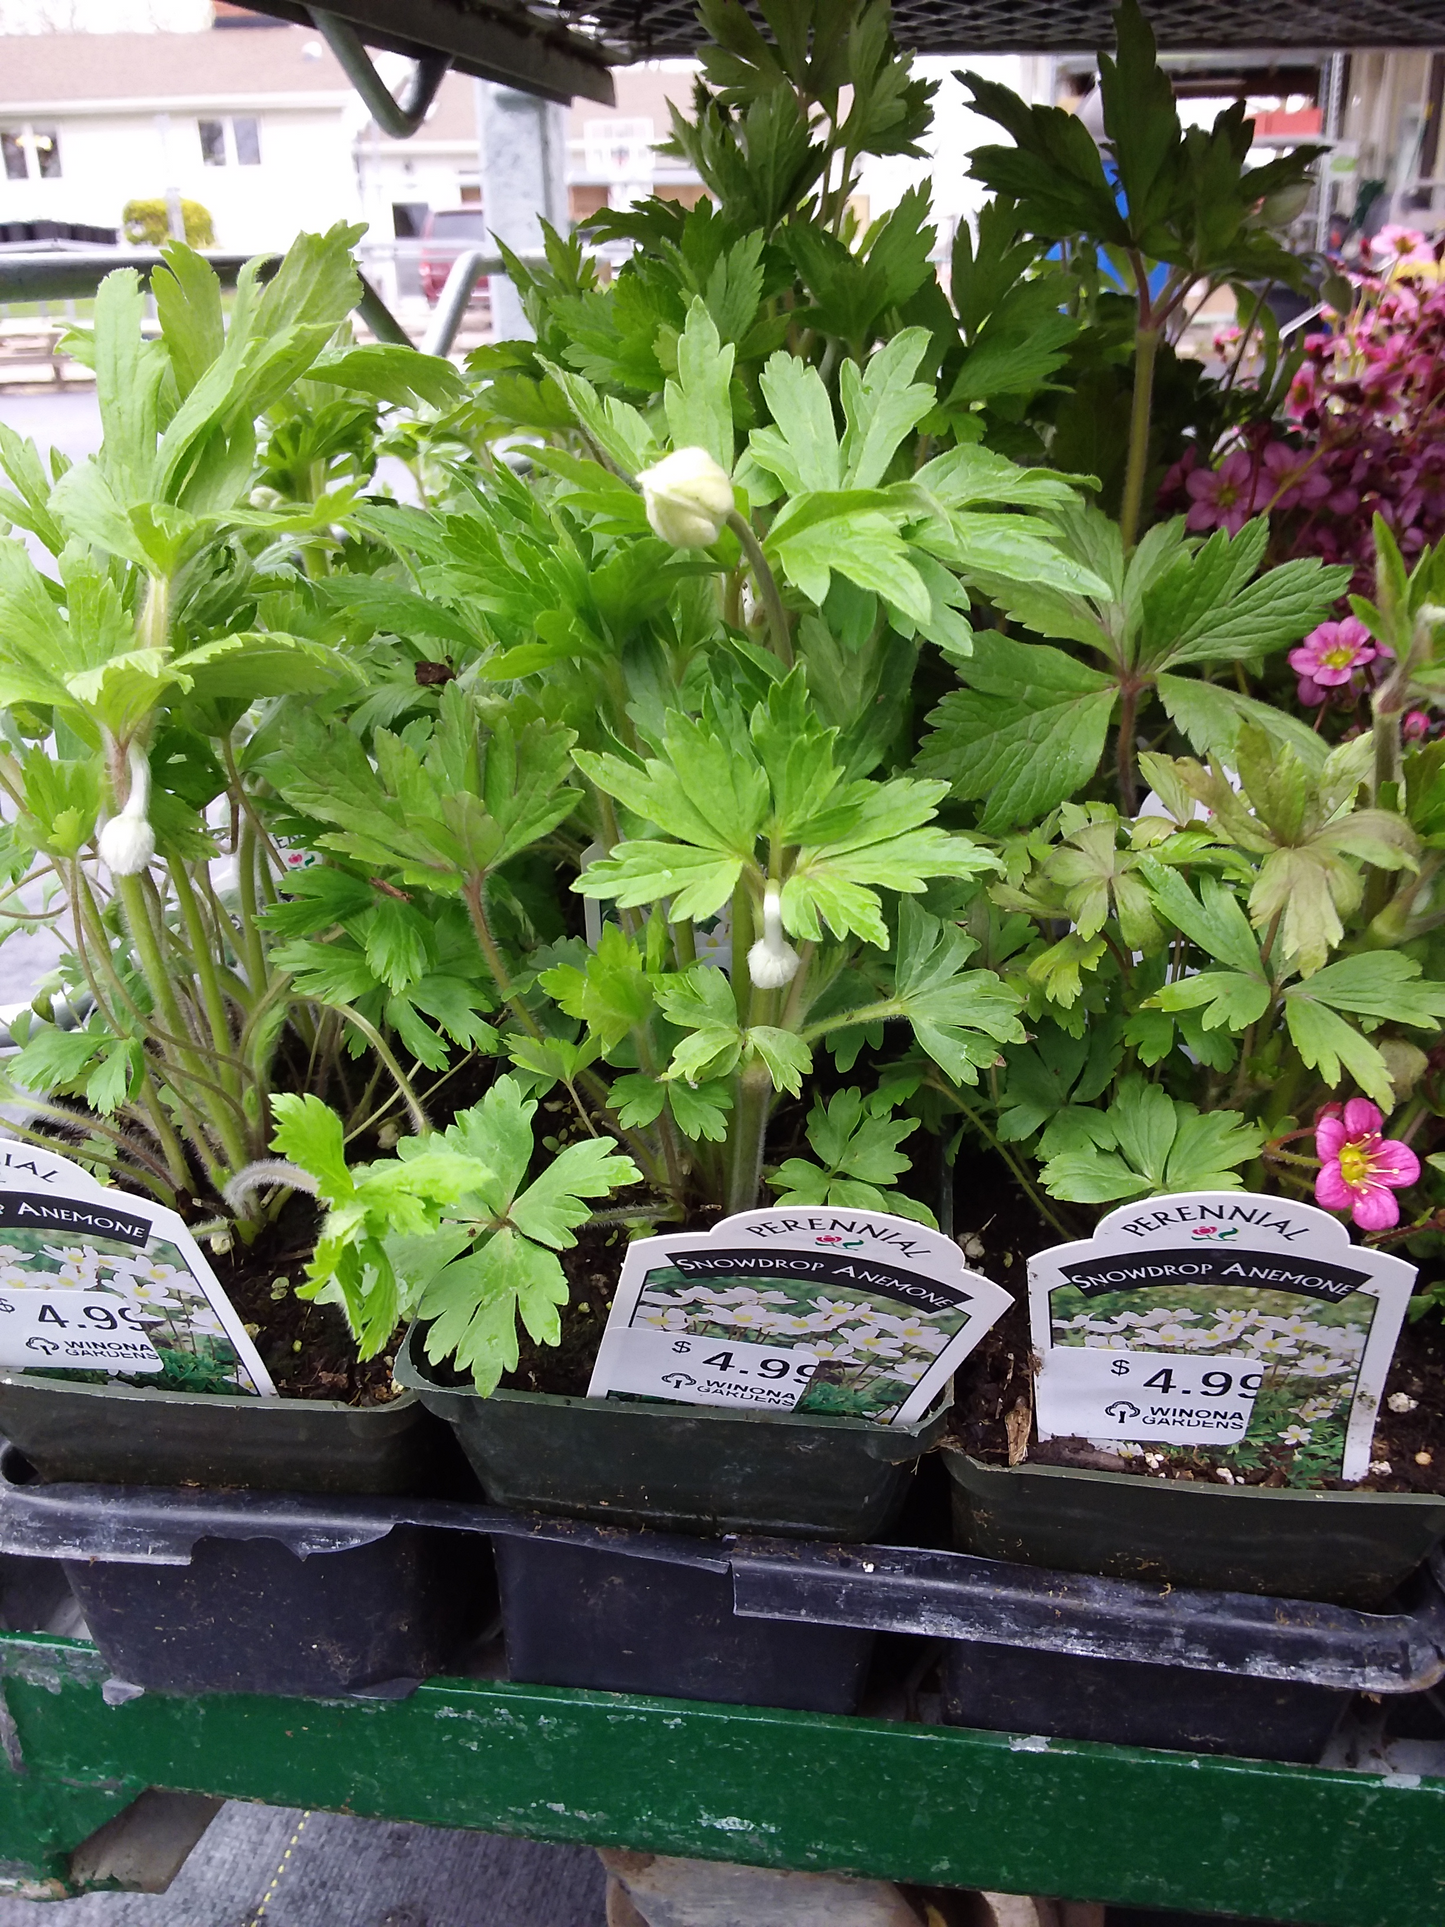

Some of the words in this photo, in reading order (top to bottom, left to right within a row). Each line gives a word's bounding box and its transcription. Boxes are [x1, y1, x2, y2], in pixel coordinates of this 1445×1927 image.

[18, 1202, 146, 1240] ANEMONE
[1121, 1204, 1311, 1241] PERENNIAL
[745, 1217, 932, 1260] PERENNIAL
[675, 1257, 825, 1273] SNOWDROP
[832, 1265, 955, 1309] ANEMONE
[1071, 1262, 1214, 1290] SNOWDROP
[1220, 1262, 1356, 1297] ANEMONE
[64, 1341, 154, 1353] WINONA
[64, 1349, 159, 1360] GARDENS
[697, 1385, 796, 1407] GARDENS
[706, 1379, 796, 1401] WINONA
[1142, 1415, 1244, 1430] GARDENS
[1150, 1406, 1245, 1421] WINONA
